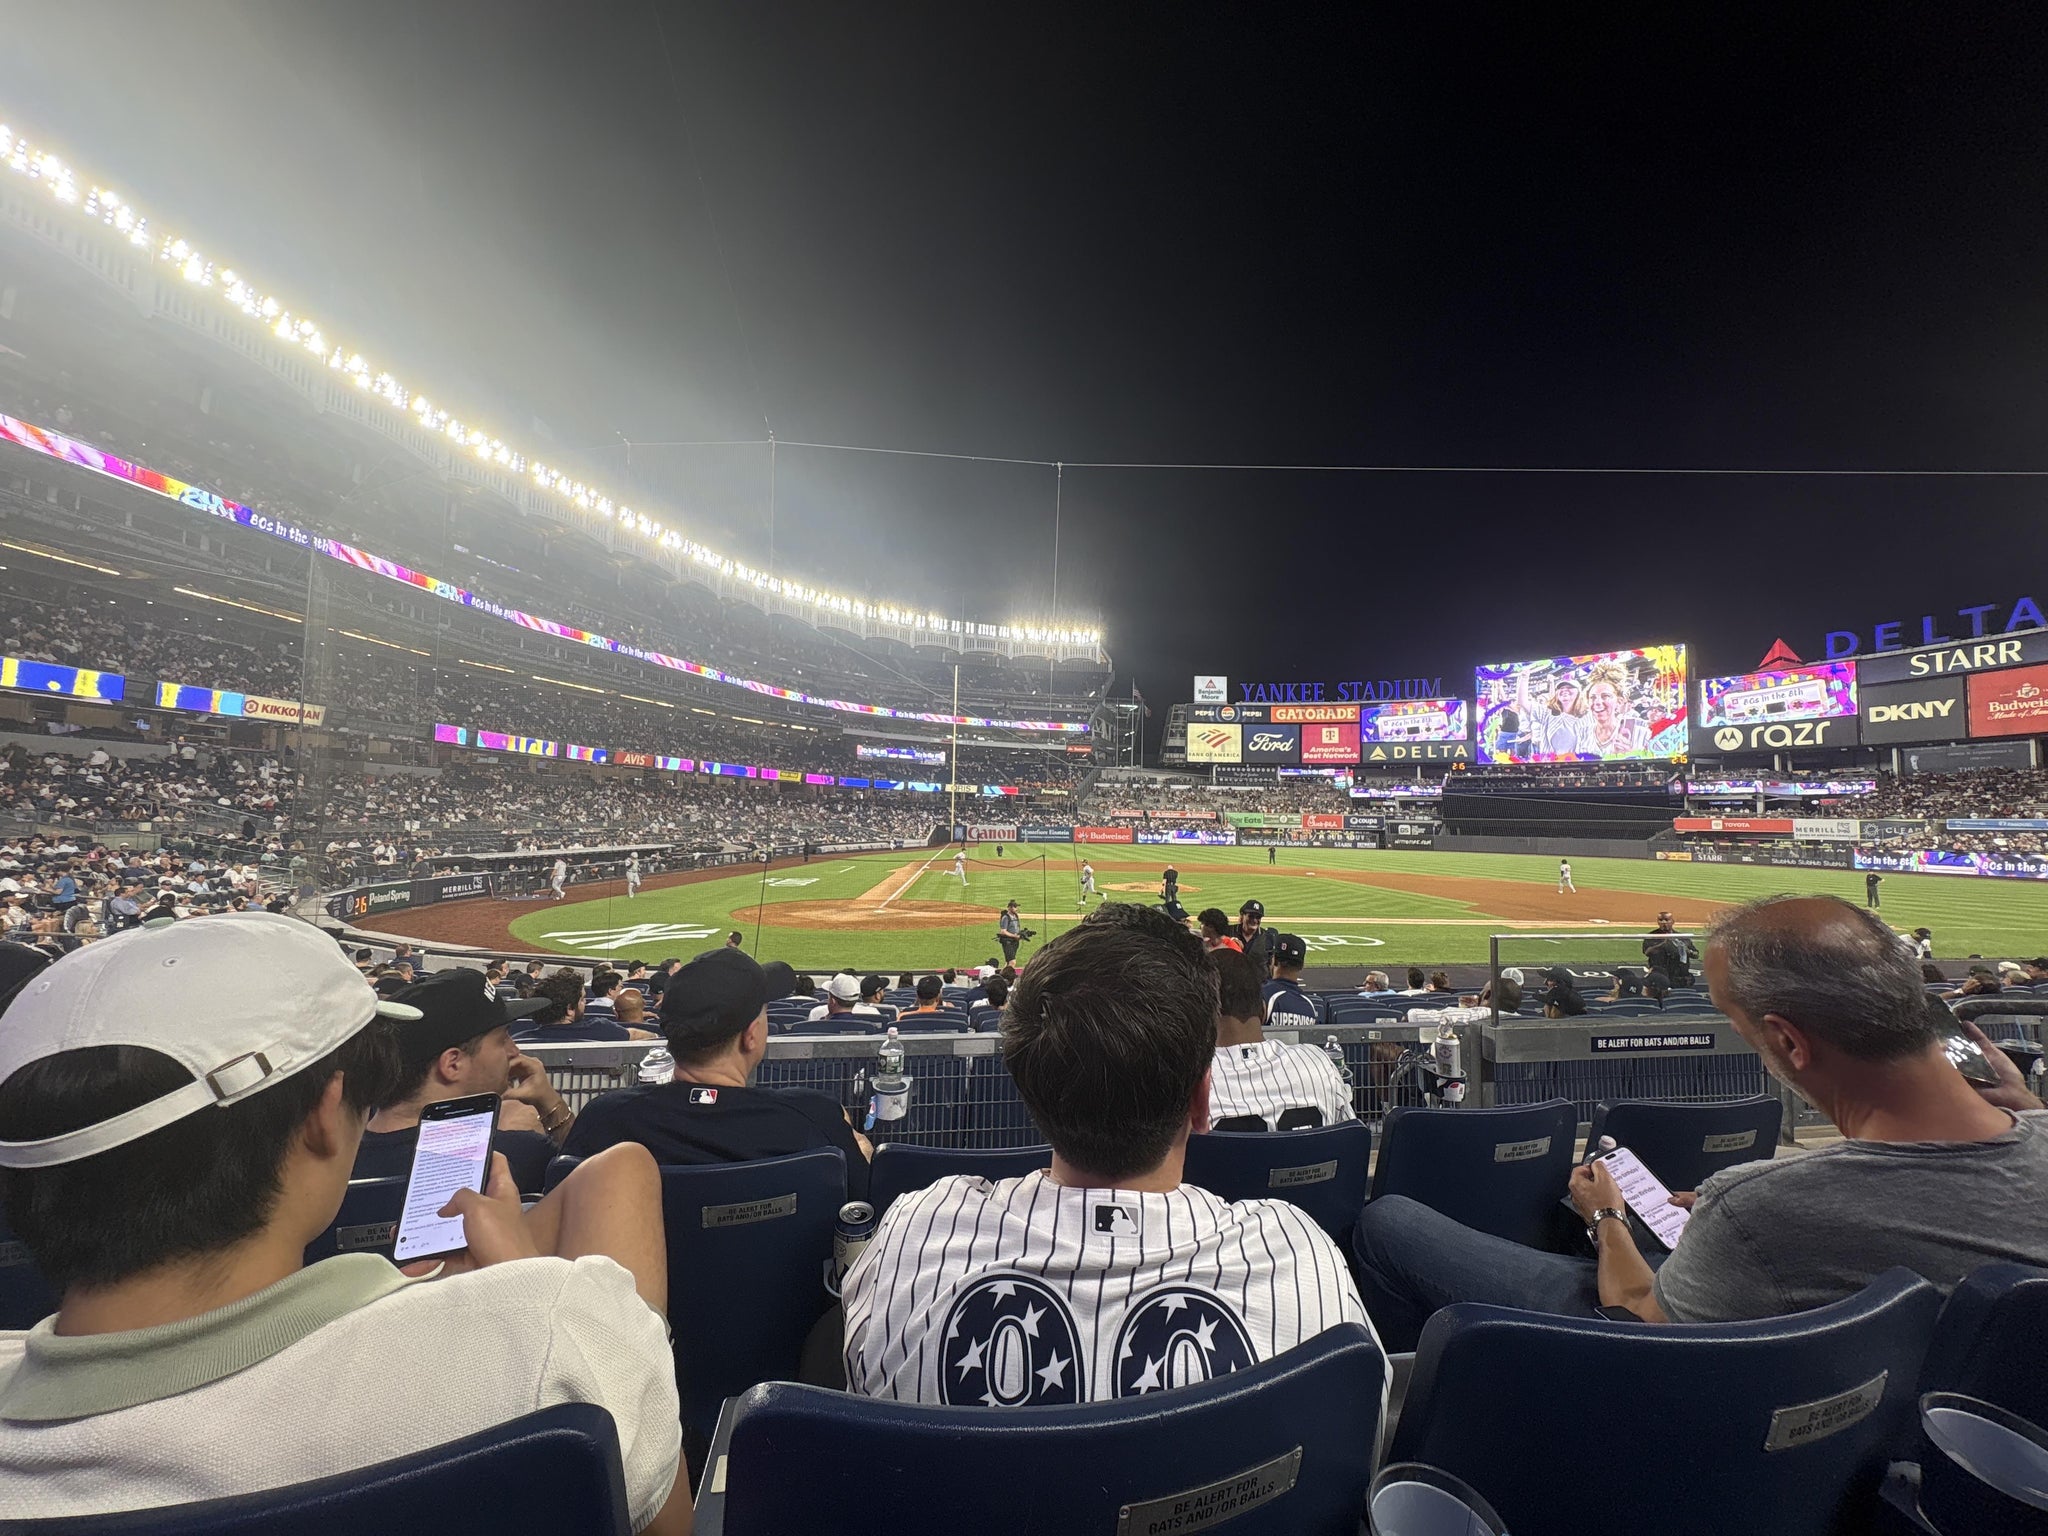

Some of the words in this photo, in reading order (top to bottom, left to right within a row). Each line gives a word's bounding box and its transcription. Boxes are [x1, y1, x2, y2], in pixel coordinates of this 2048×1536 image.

[250, 513, 274, 532] 80s
[289, 524, 309, 545] the
[1825, 597, 2046, 660] DELTA
[1910, 640, 2023, 676] STARR
[1198, 688, 1224, 696] Benjamin
[1240, 682, 1325, 702] YANKEE
[1337, 677, 1442, 701] STADIUM
[1276, 708, 1356, 720] GATORADE
[1869, 699, 1956, 723] DKNY
[1248, 732, 1295, 752] Ford
[1750, 721, 1831, 749] razr
[1393, 745, 1468, 760] DELTA
[623, 754, 646, 766] AVIS
[1244, 816, 1262, 824] Eats
[968, 826, 1015, 840] Canon
[1090, 832, 1130, 840] Budweiser
[1856, 856, 1872, 864] 80s
[1873, 855, 1881, 864] in
[1883, 855, 1897, 866] the
[1982, 861, 2003, 871] 80s
[2005, 861, 2015, 872] in
[2017, 862, 2037, 872] the
[442, 884, 472, 894] MERRILL
[369, 891, 391, 906] Poland
[391, 889, 411, 903] Spring
[1597, 1039, 1608, 1048] BE
[1608, 1038, 1630, 1048] ALERT
[1630, 1038, 1644, 1047] FOR
[1644, 1037, 1662, 1047] BATS
[1662, 1036, 1689, 1046] AND/OR
[1690, 1036, 1710, 1045] BALLS
[717, 1214, 735, 1223] BATS
[735, 1211, 762, 1222] AND/OR
[763, 1207, 783, 1217] BALLS
[738, 1204, 759, 1214] ALERT
[760, 1202, 772, 1211] FOR
[367, 1227, 376, 1236] BE
[379, 1225, 390, 1234] AL
[354, 1235, 375, 1244] BATS
[1174, 1502, 1191, 1516] BE
[1194, 1487, 1233, 1510] ALERT
[1236, 1476, 1258, 1494] FOR
[1149, 1515, 1184, 1535] BATS
[1185, 1499, 1238, 1526] AND/OR
[1239, 1481, 1275, 1505] BALLS
